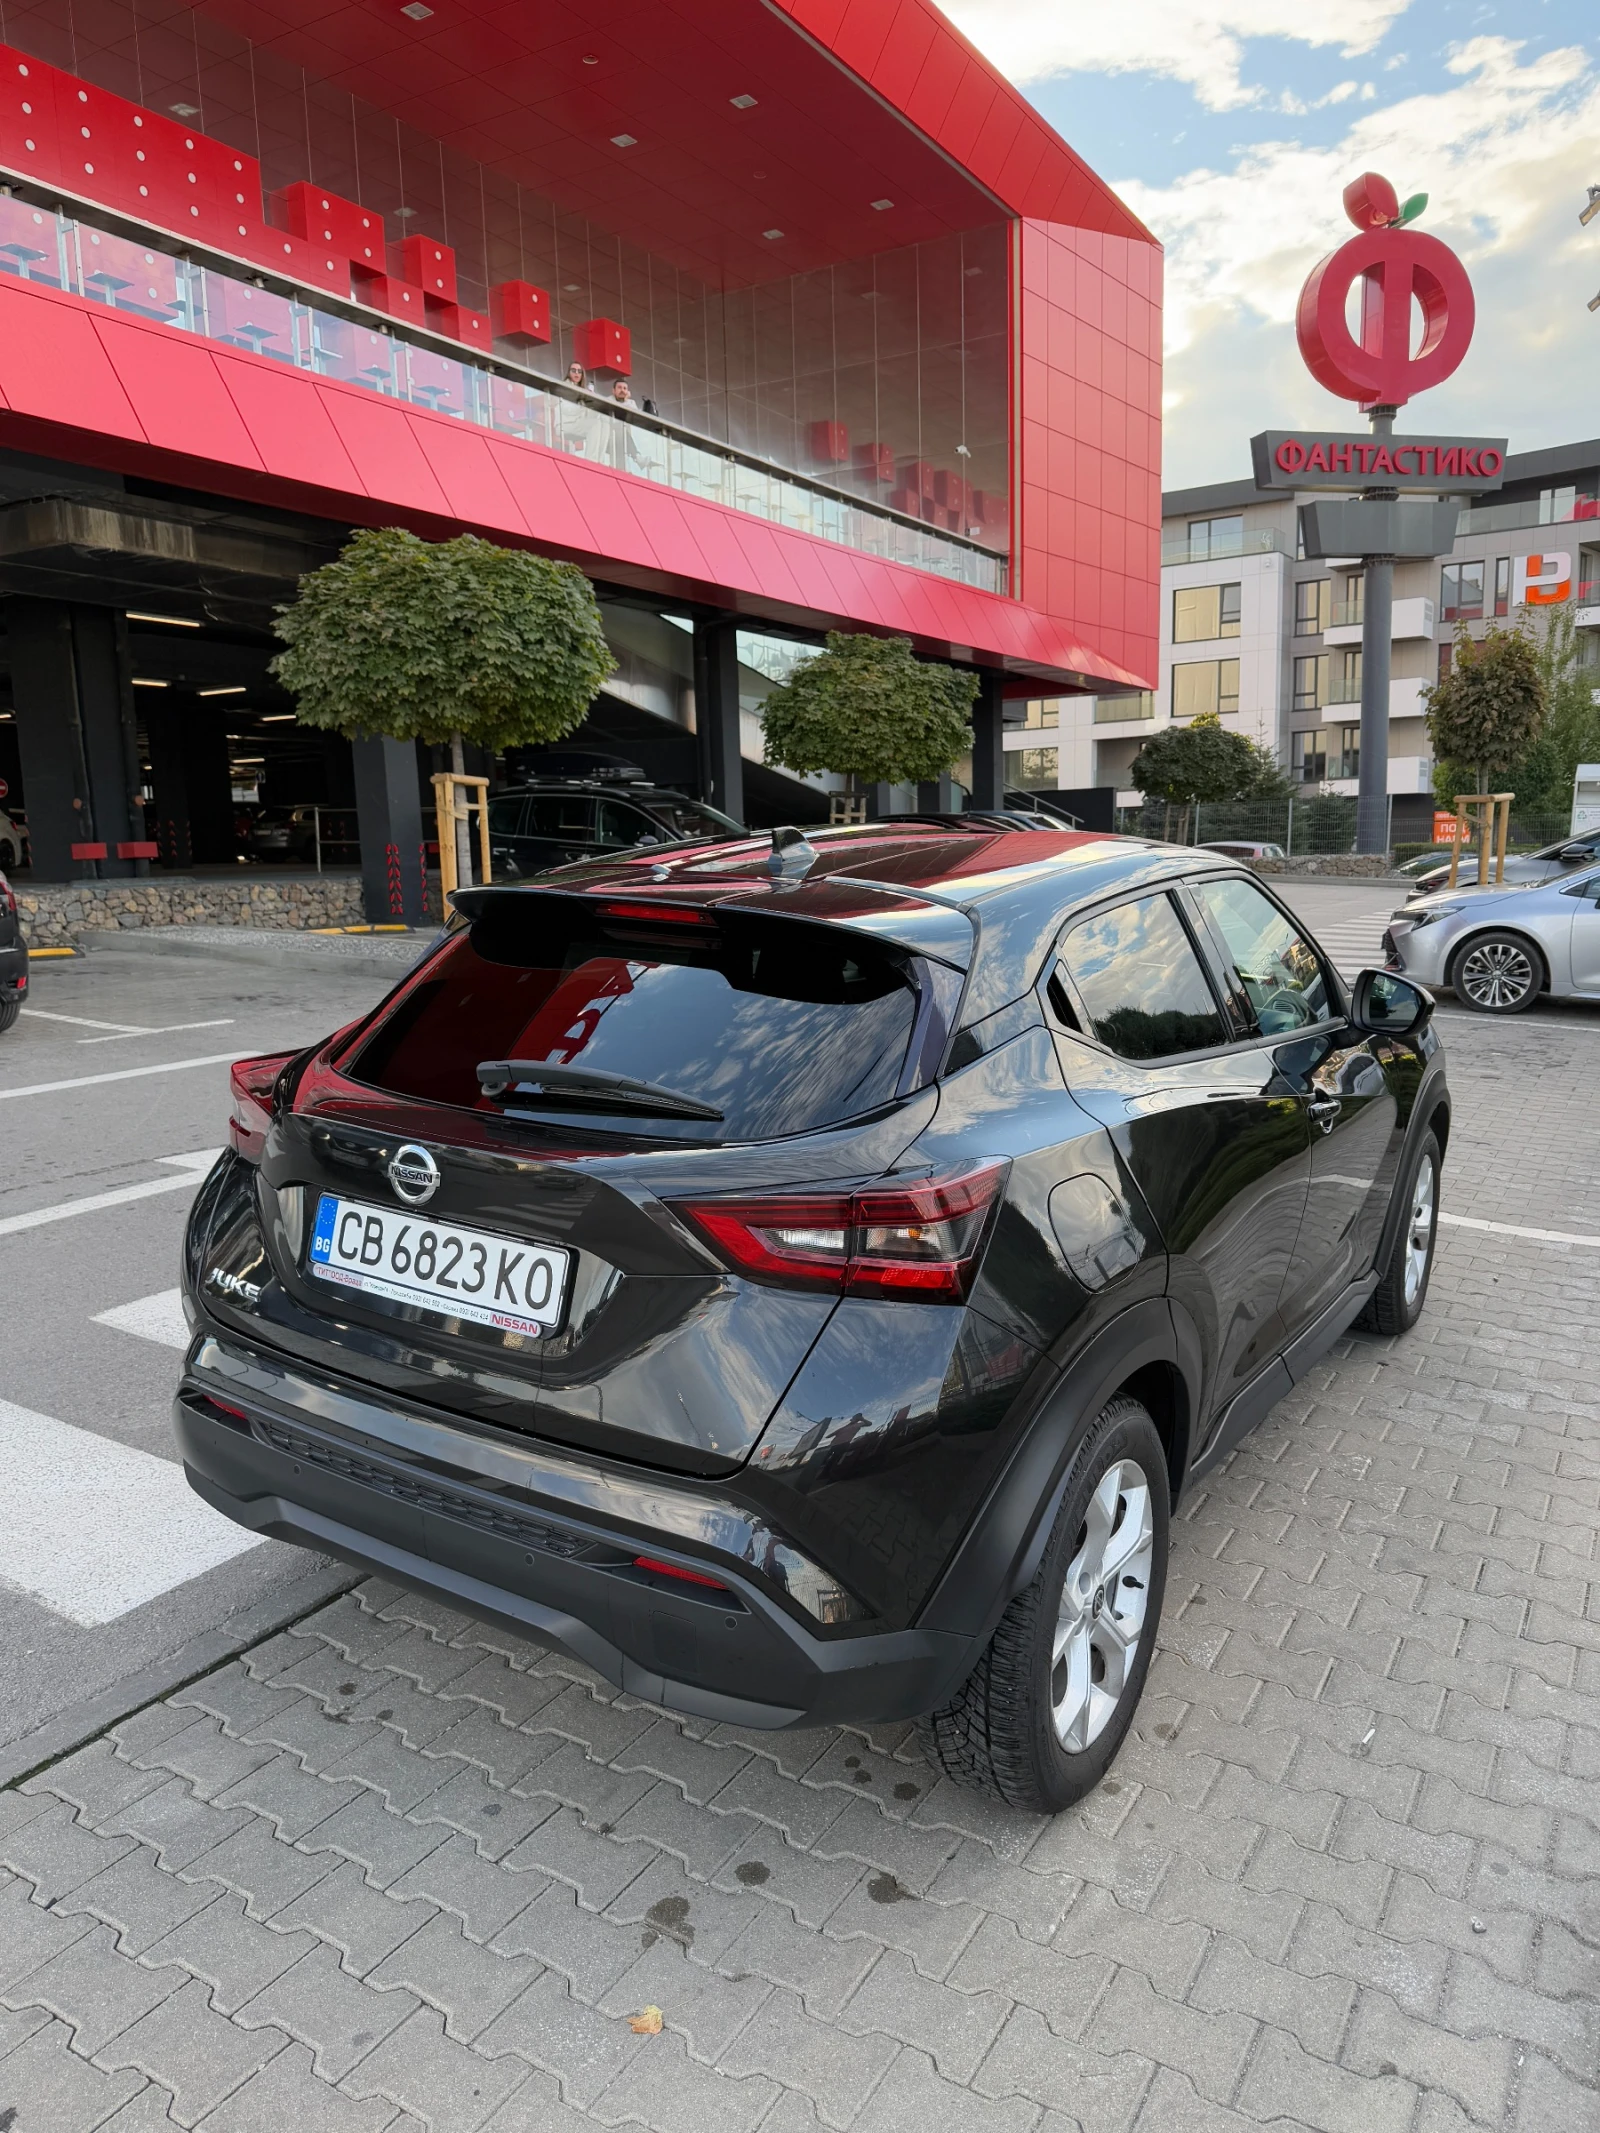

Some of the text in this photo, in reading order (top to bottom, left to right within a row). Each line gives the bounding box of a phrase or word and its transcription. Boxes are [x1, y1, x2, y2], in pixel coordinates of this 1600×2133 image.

[1275, 439, 1504, 477] ФАНТАСТИКО
[391, 1165, 433, 1184] NISSAN
[315, 1236, 331, 1253] BG
[337, 1210, 384, 1266] CB
[391, 1225, 488, 1293] 6823
[205, 1267, 261, 1302] JUKE
[492, 1314, 538, 1334] NISSAN
